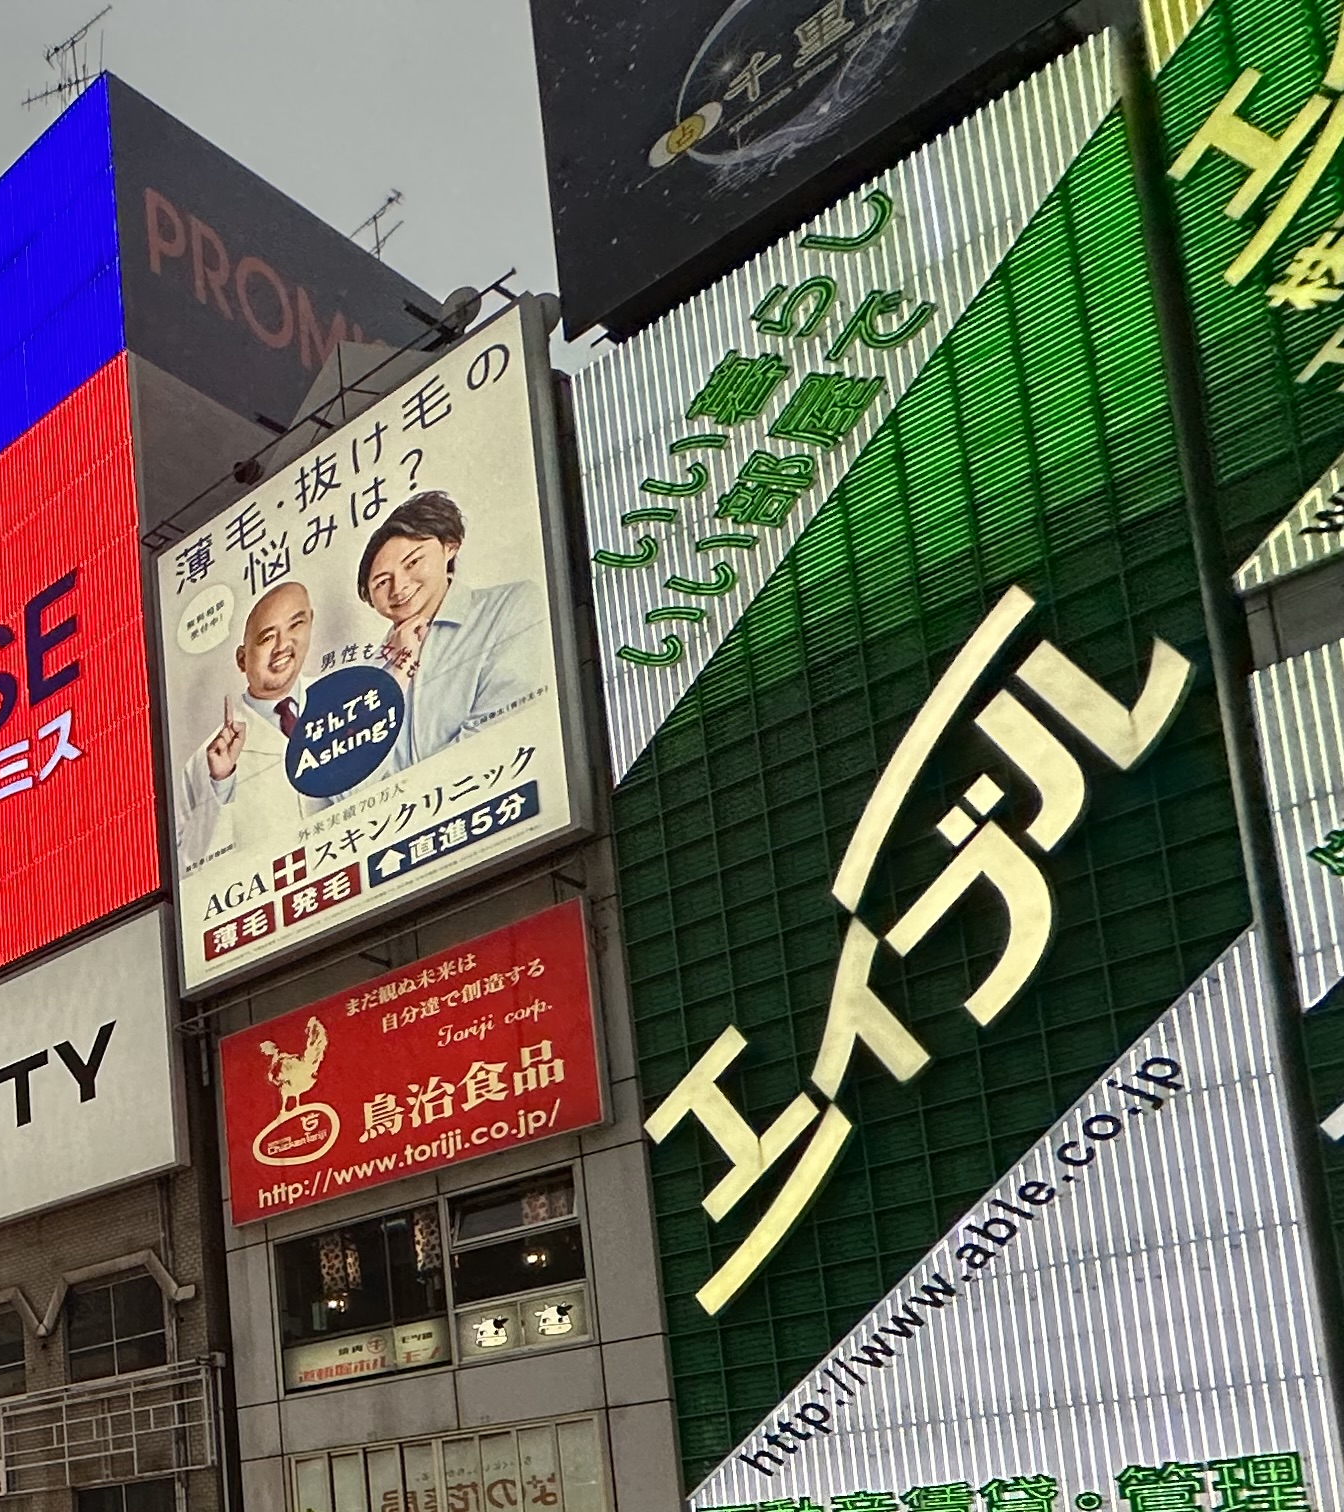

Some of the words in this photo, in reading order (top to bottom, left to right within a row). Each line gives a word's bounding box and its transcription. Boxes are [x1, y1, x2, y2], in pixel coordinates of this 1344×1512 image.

[593, 190, 894, 568] いい暮らし
[176, 344, 510, 594] 薄毛・抜け毛の
[617, 289, 940, 666] いい部屋で
[294, 707, 398, 780] Asking!
[305, 687, 382, 742] なんでも
[203, 874, 269, 921] AGA
[313, 745, 538, 870] スキンクリニック
[213, 909, 269, 953] 薄毛
[293, 872, 352, 918] 発毛
[409, 794, 528, 862] 直進5分
[345, 952, 478, 1017] まだ観ぬ未来は
[437, 1013, 495, 1048] Toriji
[504, 1002, 553, 1026] corp.
[644, 585, 1195, 1315] エイブル
[258, 1098, 562, 1209] http://www.toriji.co.jp/
[358, 1039, 566, 1144] 鳥治食品
[739, 1055, 1182, 1478] http://www.able.co.jp
